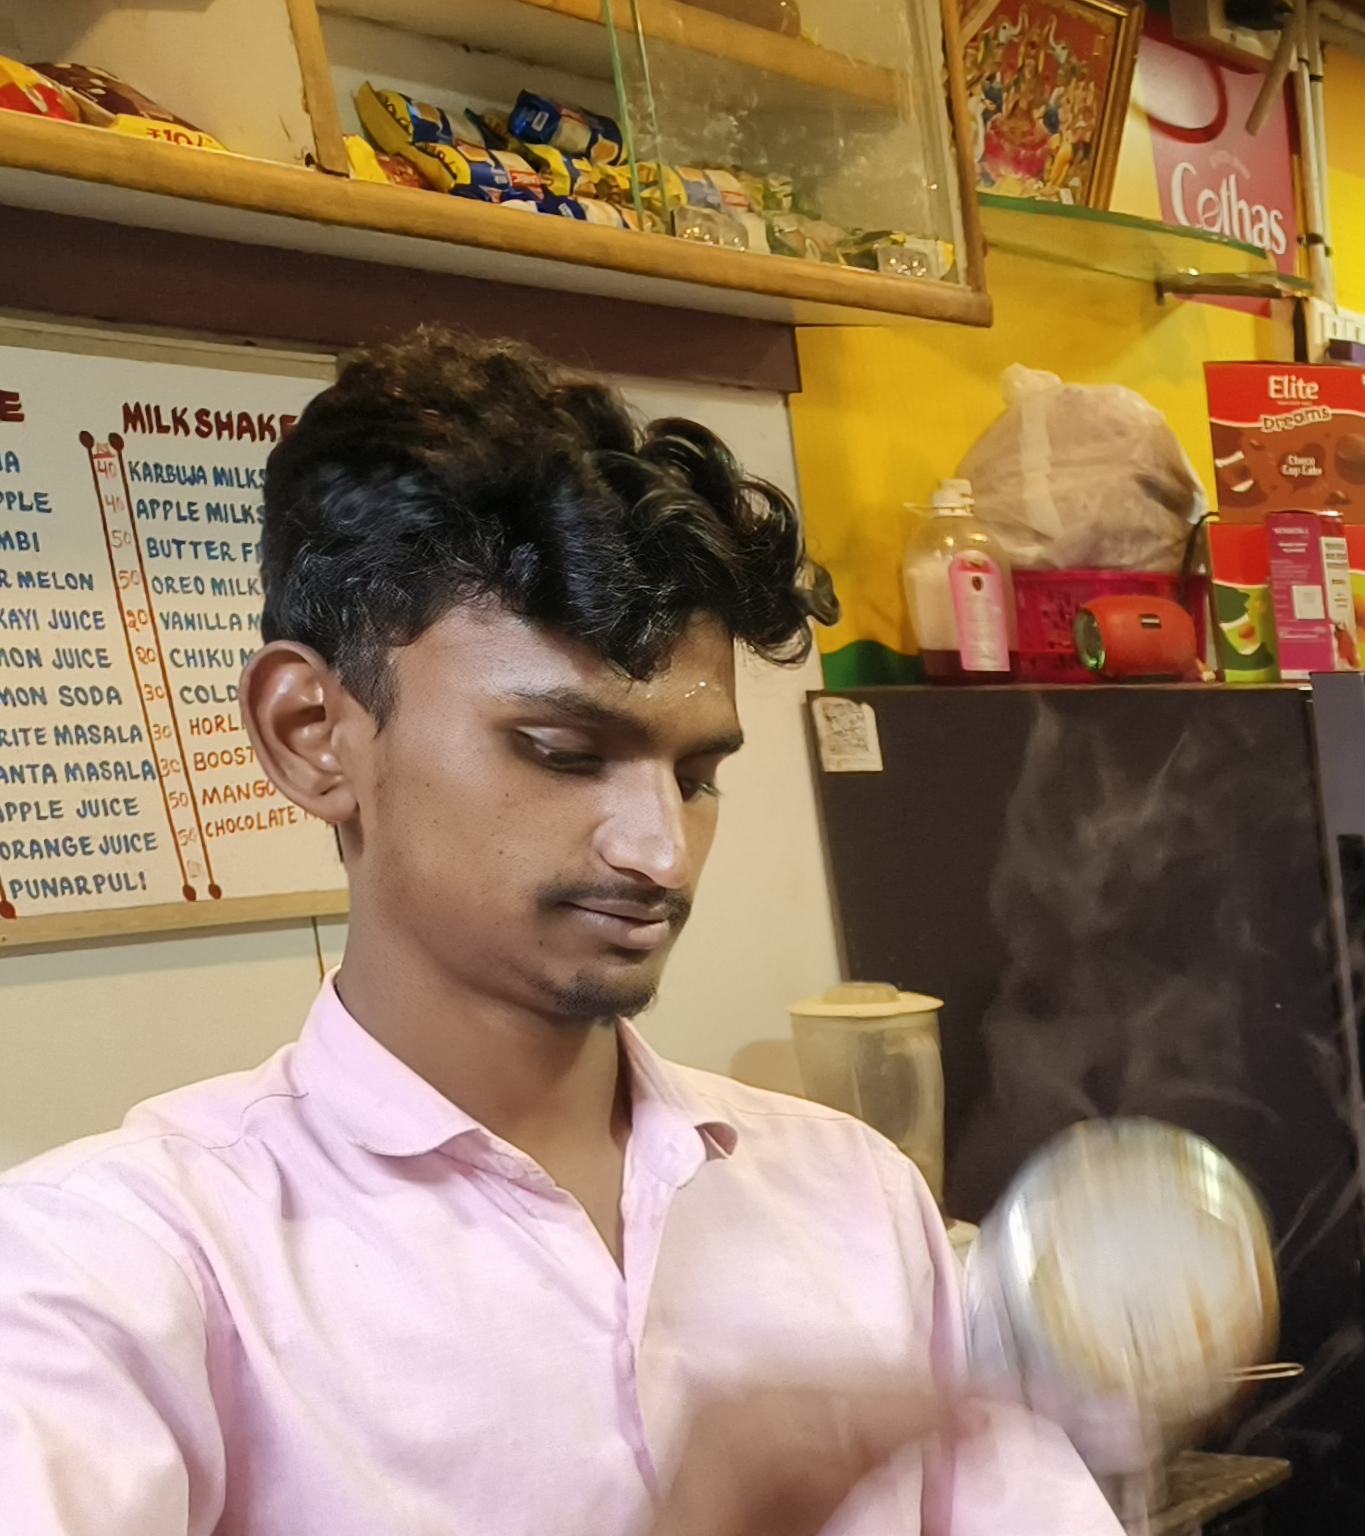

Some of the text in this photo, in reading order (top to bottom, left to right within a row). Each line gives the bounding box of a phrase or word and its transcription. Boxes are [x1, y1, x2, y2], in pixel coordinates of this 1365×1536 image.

[1268, 375, 1319, 400] Elite
[1262, 407, 1331, 432] Dreams
[136, 499, 200, 522] APPLE
[146, 537, 236, 562] BUTTER
[17, 570, 94, 591] MELON
[151, 576, 205, 596] OREO
[48, 608, 106, 631] JUICE
[159, 611, 242, 631] VANILLA
[52, 647, 112, 670] JUICE
[169, 648, 234, 669] CHIKU
[58, 685, 123, 707] SODA
[179, 684, 240, 705] COLD
[53, 724, 143, 747] MASALA
[193, 746, 255, 772] BOOST
[64, 759, 157, 784] MASALA
[201, 779, 276, 806] MANGO
[76, 797, 140, 819] JUICE
[205, 805, 297, 838] CHOCOLATE
[0, 832, 158, 861] ORANGE JUICE
